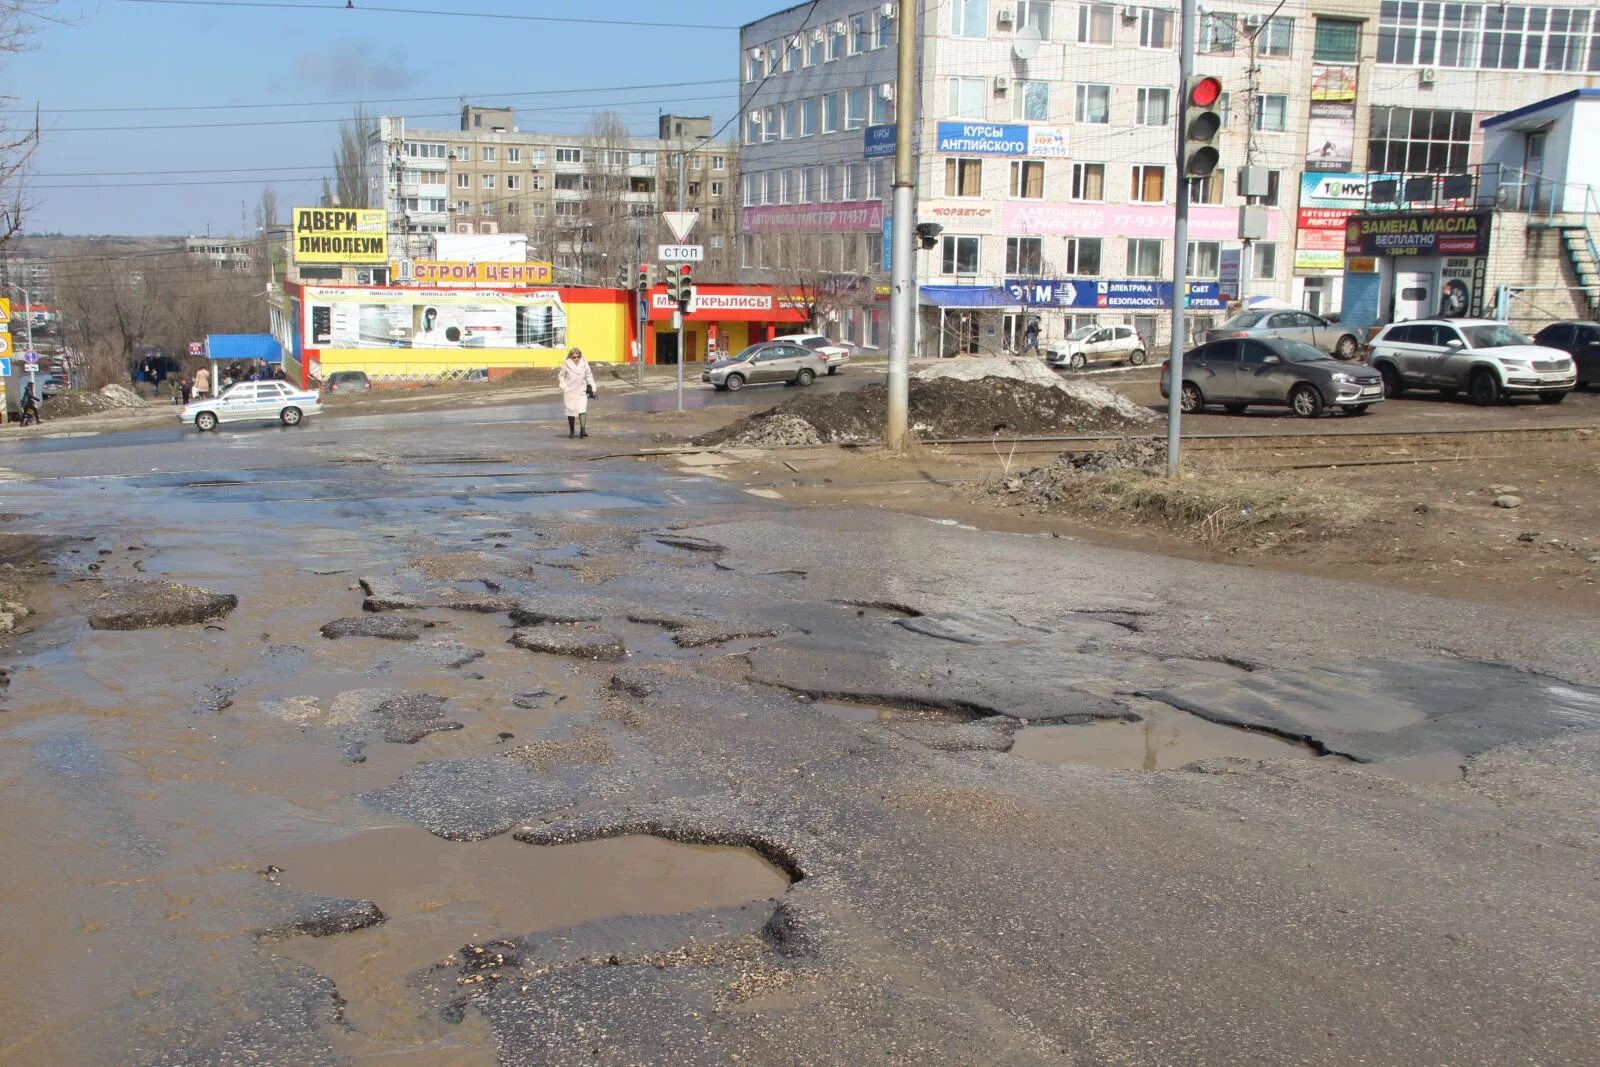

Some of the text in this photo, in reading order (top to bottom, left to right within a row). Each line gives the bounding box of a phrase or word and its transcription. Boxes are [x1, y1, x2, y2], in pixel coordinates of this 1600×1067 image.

[873, 128, 890, 139] КУРСЫ
[963, 126, 1003, 138] КУРСЫ
[940, 138, 1025, 153] АНГЛИЙСКОГО
[839, 208, 868, 224] 77-93-77
[1028, 207, 1104, 218] АВТОШКОЛА
[1301, 209, 1352, 217] АВТОШКОЛА
[297, 210, 358, 233] ДВЕРИ
[1031, 218, 1104, 230] МАСТЕР
[1307, 217, 1346, 226] МАСТЕР
[1361, 217, 1477, 234] ЗАМЕНА МАСЛА
[298, 236, 384, 253] ЛИНОЛЕУМ
[1375, 234, 1434, 245] БЕСПЛАТНО
[664, 248, 698, 257] СТОП
[414, 261, 549, 280] СТРОЙ ЦЕНТР
[1442, 268, 1472, 278] МОНТАЖ
[1010, 285, 1052, 302] ЭТМ
[1109, 284, 1153, 292] ЭЛЕКТРИКА
[695, 297, 770, 309] ТКРЫЛИСЬ!
[1108, 297, 1220, 306] БЕЗОПАСНОСТЬ КРЕПЕЖ
